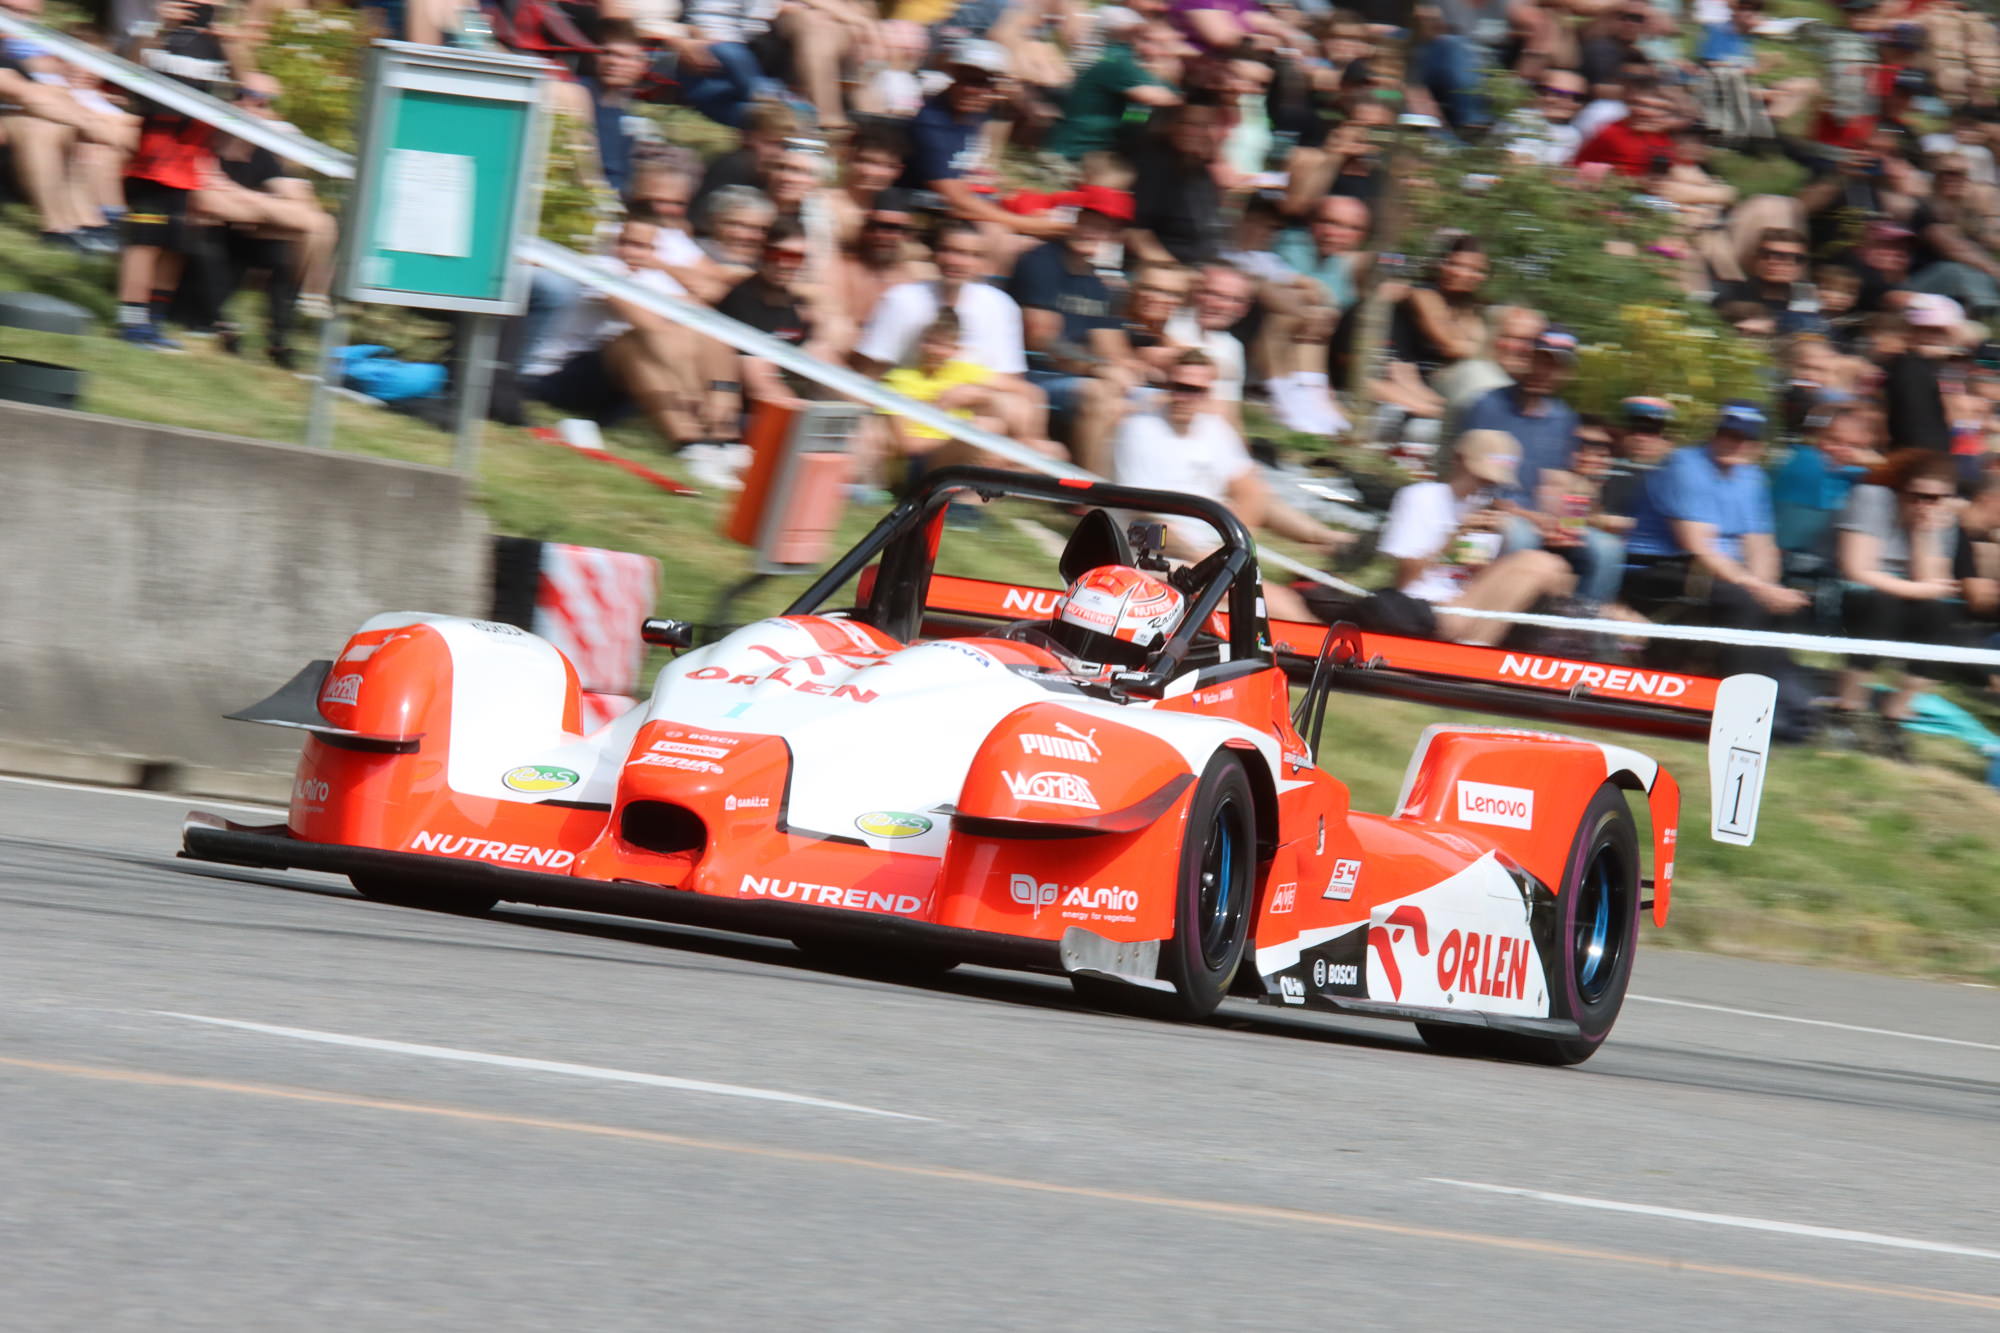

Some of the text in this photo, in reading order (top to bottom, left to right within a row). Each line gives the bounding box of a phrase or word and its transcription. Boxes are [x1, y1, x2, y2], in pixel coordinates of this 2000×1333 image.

[684, 666, 880, 704] ORLEN
[1499, 654, 1686, 698] NUTREND
[659, 743, 721, 757] Lenovo
[687, 733, 740, 745] BOSCH
[1018, 732, 1092, 763] PUMA
[1001, 770, 1100, 808] WOMBAT
[1464, 789, 1528, 819] Lenovo
[1730, 772, 1745, 826] 1
[411, 830, 575, 869] NUTREND
[740, 874, 921, 914] NUTREND
[1328, 963, 1358, 986] BOSCH
[1437, 928, 1531, 1001] ORLEN
